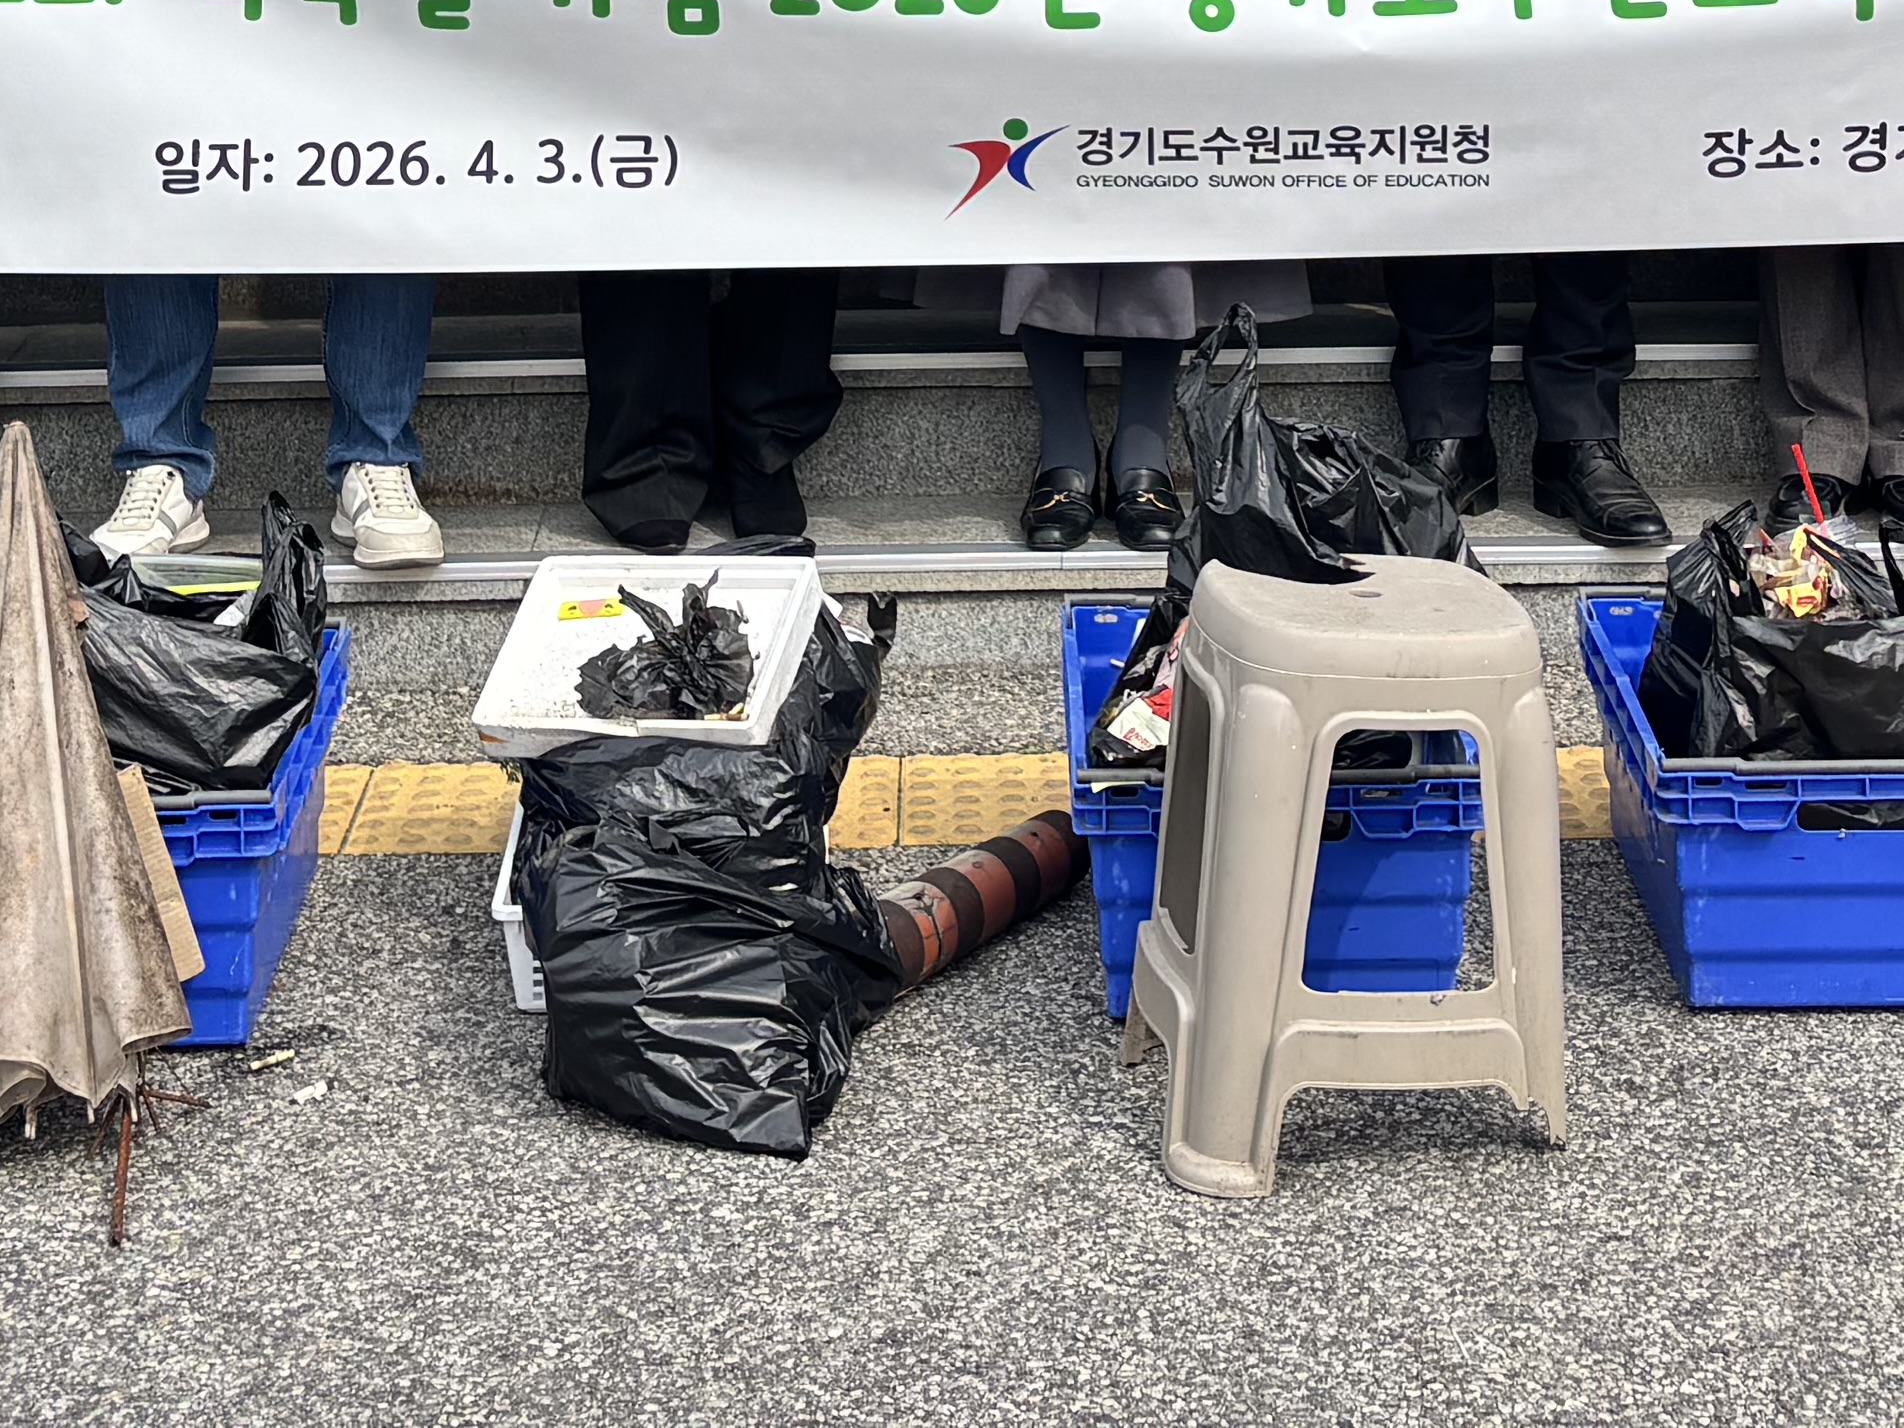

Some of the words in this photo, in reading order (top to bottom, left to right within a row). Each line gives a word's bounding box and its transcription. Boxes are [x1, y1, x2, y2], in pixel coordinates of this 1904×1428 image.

[154, 137, 275, 196] 일자:
[1075, 123, 1491, 167] 경기도수원교육지원청
[1701, 126, 1821, 180] 장소:
[1076, 174, 1200, 189] GYEONGGIDO
[1208, 174, 1276, 189] SUWON
[1281, 174, 1348, 189] OFFICE
[1353, 174, 1379, 189] OF
[1384, 174, 1491, 189] EDUCATION
